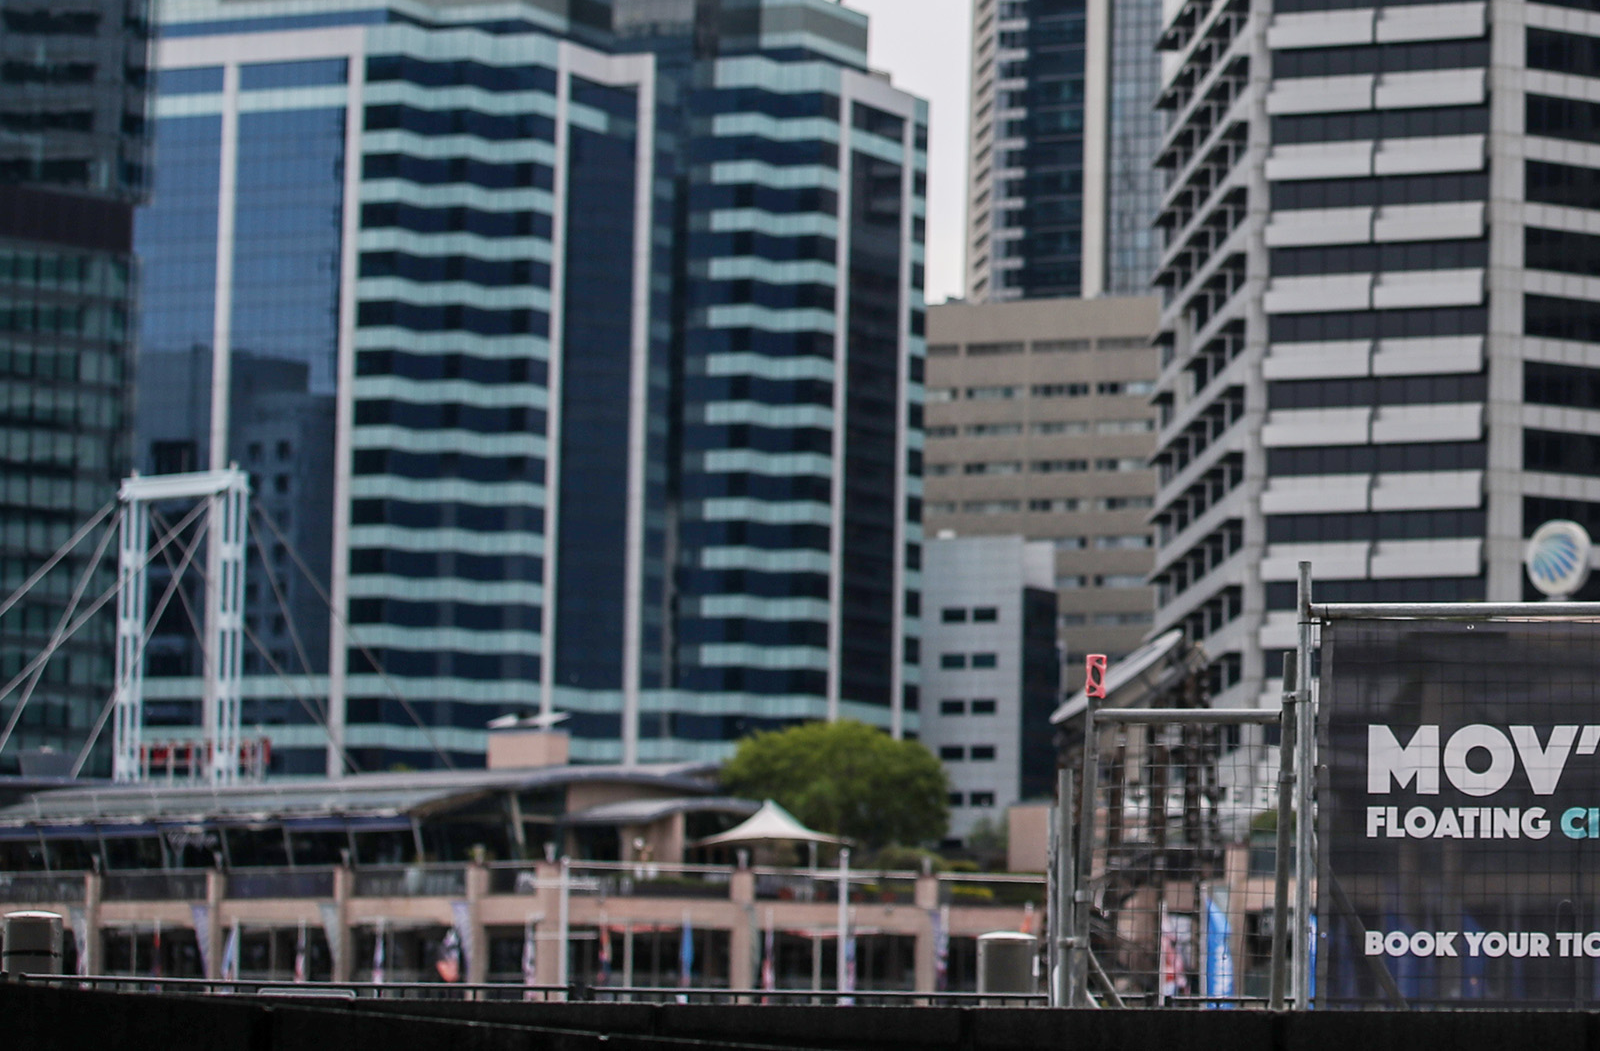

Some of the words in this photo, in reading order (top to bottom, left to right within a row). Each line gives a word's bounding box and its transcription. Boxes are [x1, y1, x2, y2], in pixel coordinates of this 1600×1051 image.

[1366, 806, 1551, 840] FLOATING
[1364, 930, 1458, 957] BOOK
[1463, 931, 1550, 958] YOUR
